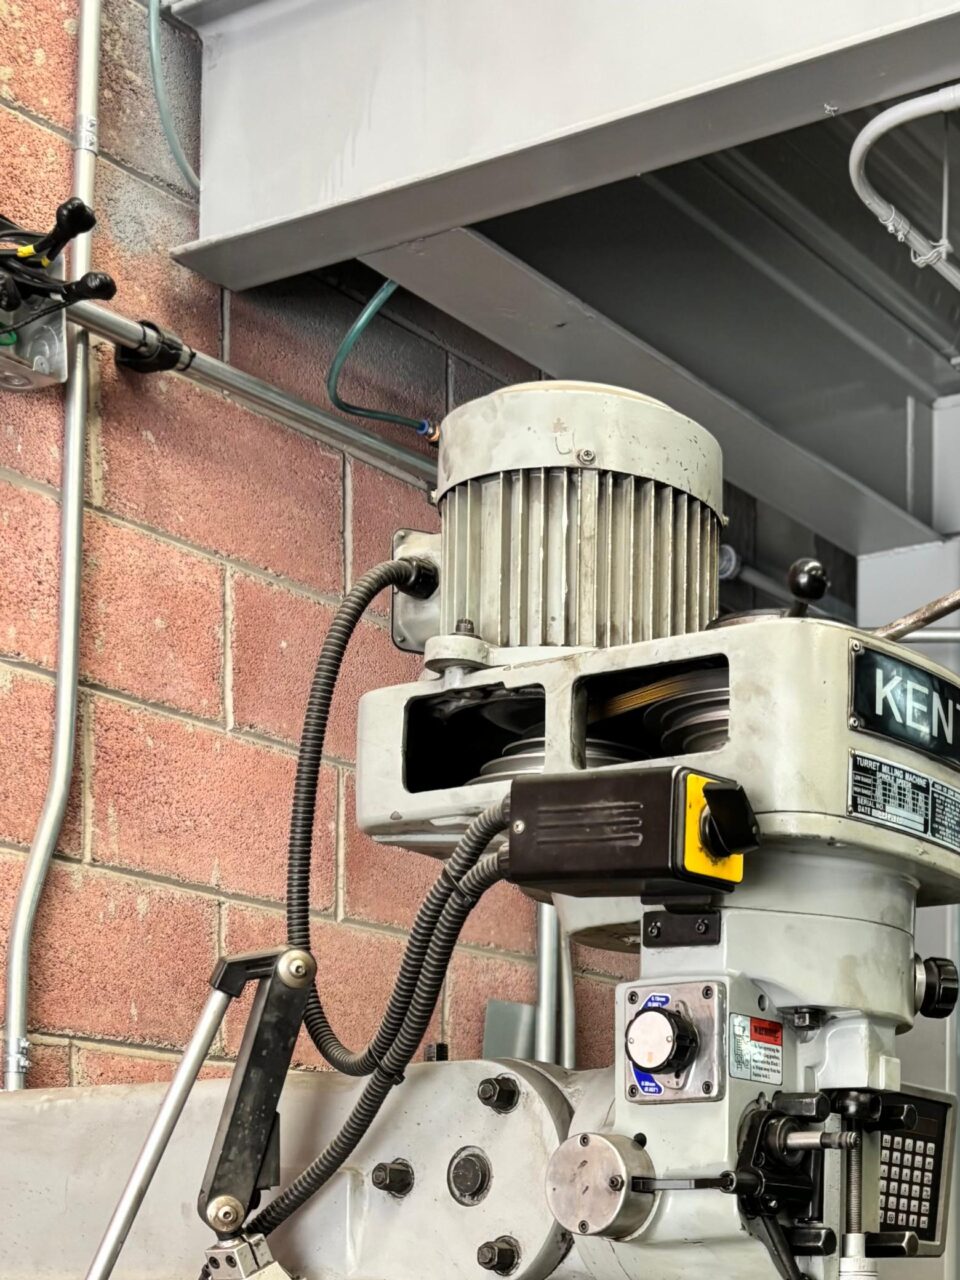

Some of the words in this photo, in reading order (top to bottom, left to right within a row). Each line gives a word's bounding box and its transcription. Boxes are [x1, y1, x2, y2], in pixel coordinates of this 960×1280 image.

[856, 756, 880, 771] TURRET
[881, 764, 904, 779] MILLING
[905, 772, 928, 788] MACHINE
[857, 805, 871, 815] DATE
